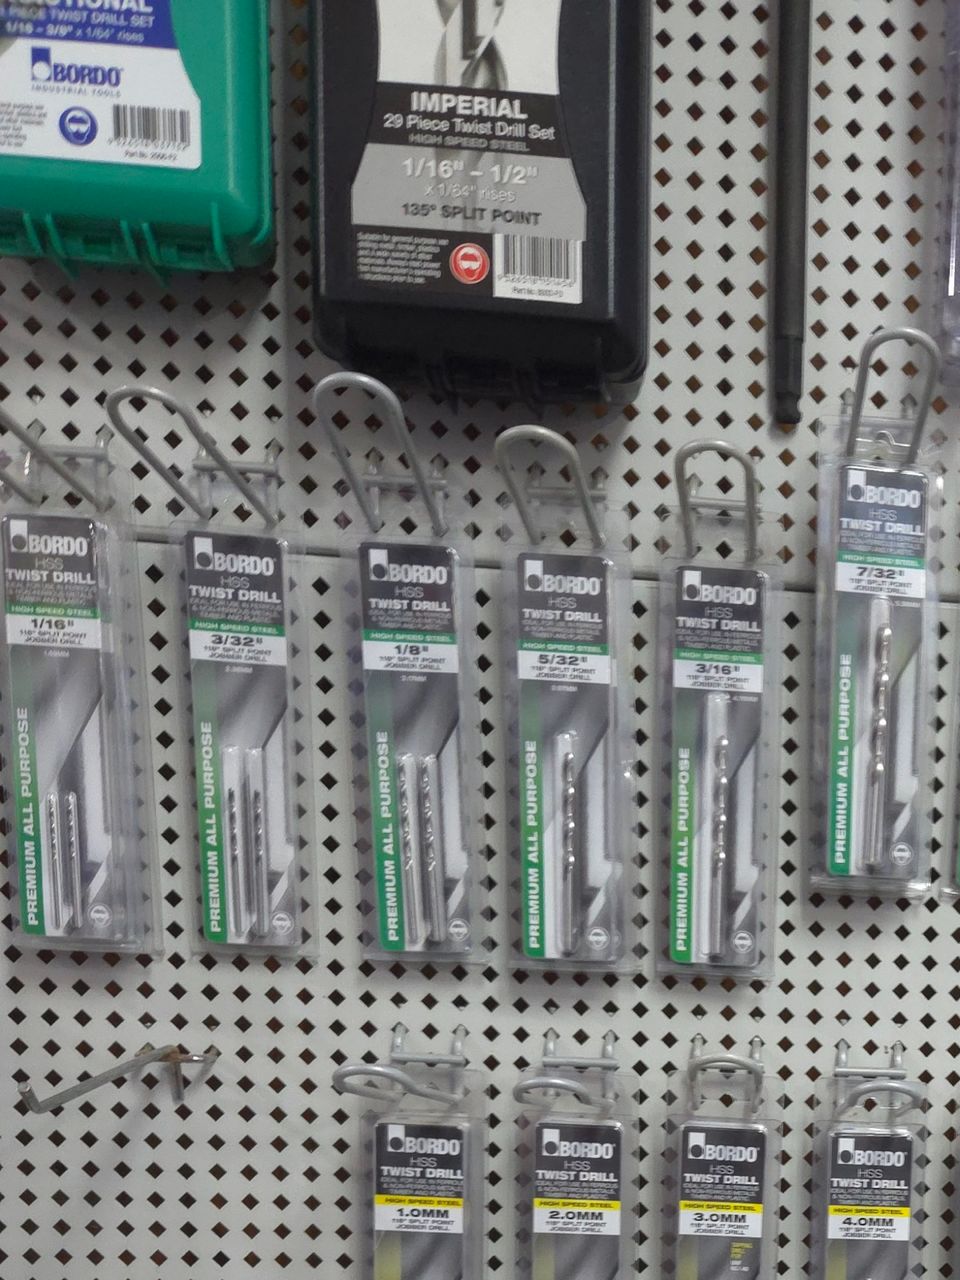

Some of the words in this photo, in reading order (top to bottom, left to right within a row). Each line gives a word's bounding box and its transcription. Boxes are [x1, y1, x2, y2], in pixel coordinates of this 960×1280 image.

[53, 63, 121, 86] BORDO
[411, 91, 528, 119] IMPERIAL
[383, 114, 402, 128] 29
[406, 115, 449, 131] Piece
[453, 118, 492, 135] Twist
[495, 122, 526, 137] Drill
[528, 124, 555, 139] Set
[441, 204, 487, 220] SPLIT
[492, 208, 542, 225] POINT
[865, 488, 921, 508] BORDO
[29, 535, 88, 556] BORDO
[214, 553, 275, 576] BORDO
[388, 564, 448, 584] BORDO
[6, 568, 49, 582] TWIST
[53, 571, 96, 584] DRILL
[543, 575, 601, 595] BORDO
[17, 707, 32, 798] PURPOSE
[25, 803, 35, 836] ALL
[25, 841, 39, 926] PREMIUM
[404, 1137, 460, 1156] BORDO
[558, 1141, 613, 1159] BORDO
[704, 1145, 757, 1162] BORDO
[854, 1150, 905, 1167] BORDO
[381, 1166, 420, 1177] TWIST
[425, 1168, 464, 1179] DRILL
[397, 1208, 449, 1219] 1.0MM
[548, 1210, 604, 1221] 2.0MM
[694, 1213, 747, 1223] 3.0MM
[842, 1217, 894, 1227] 4.0MM
